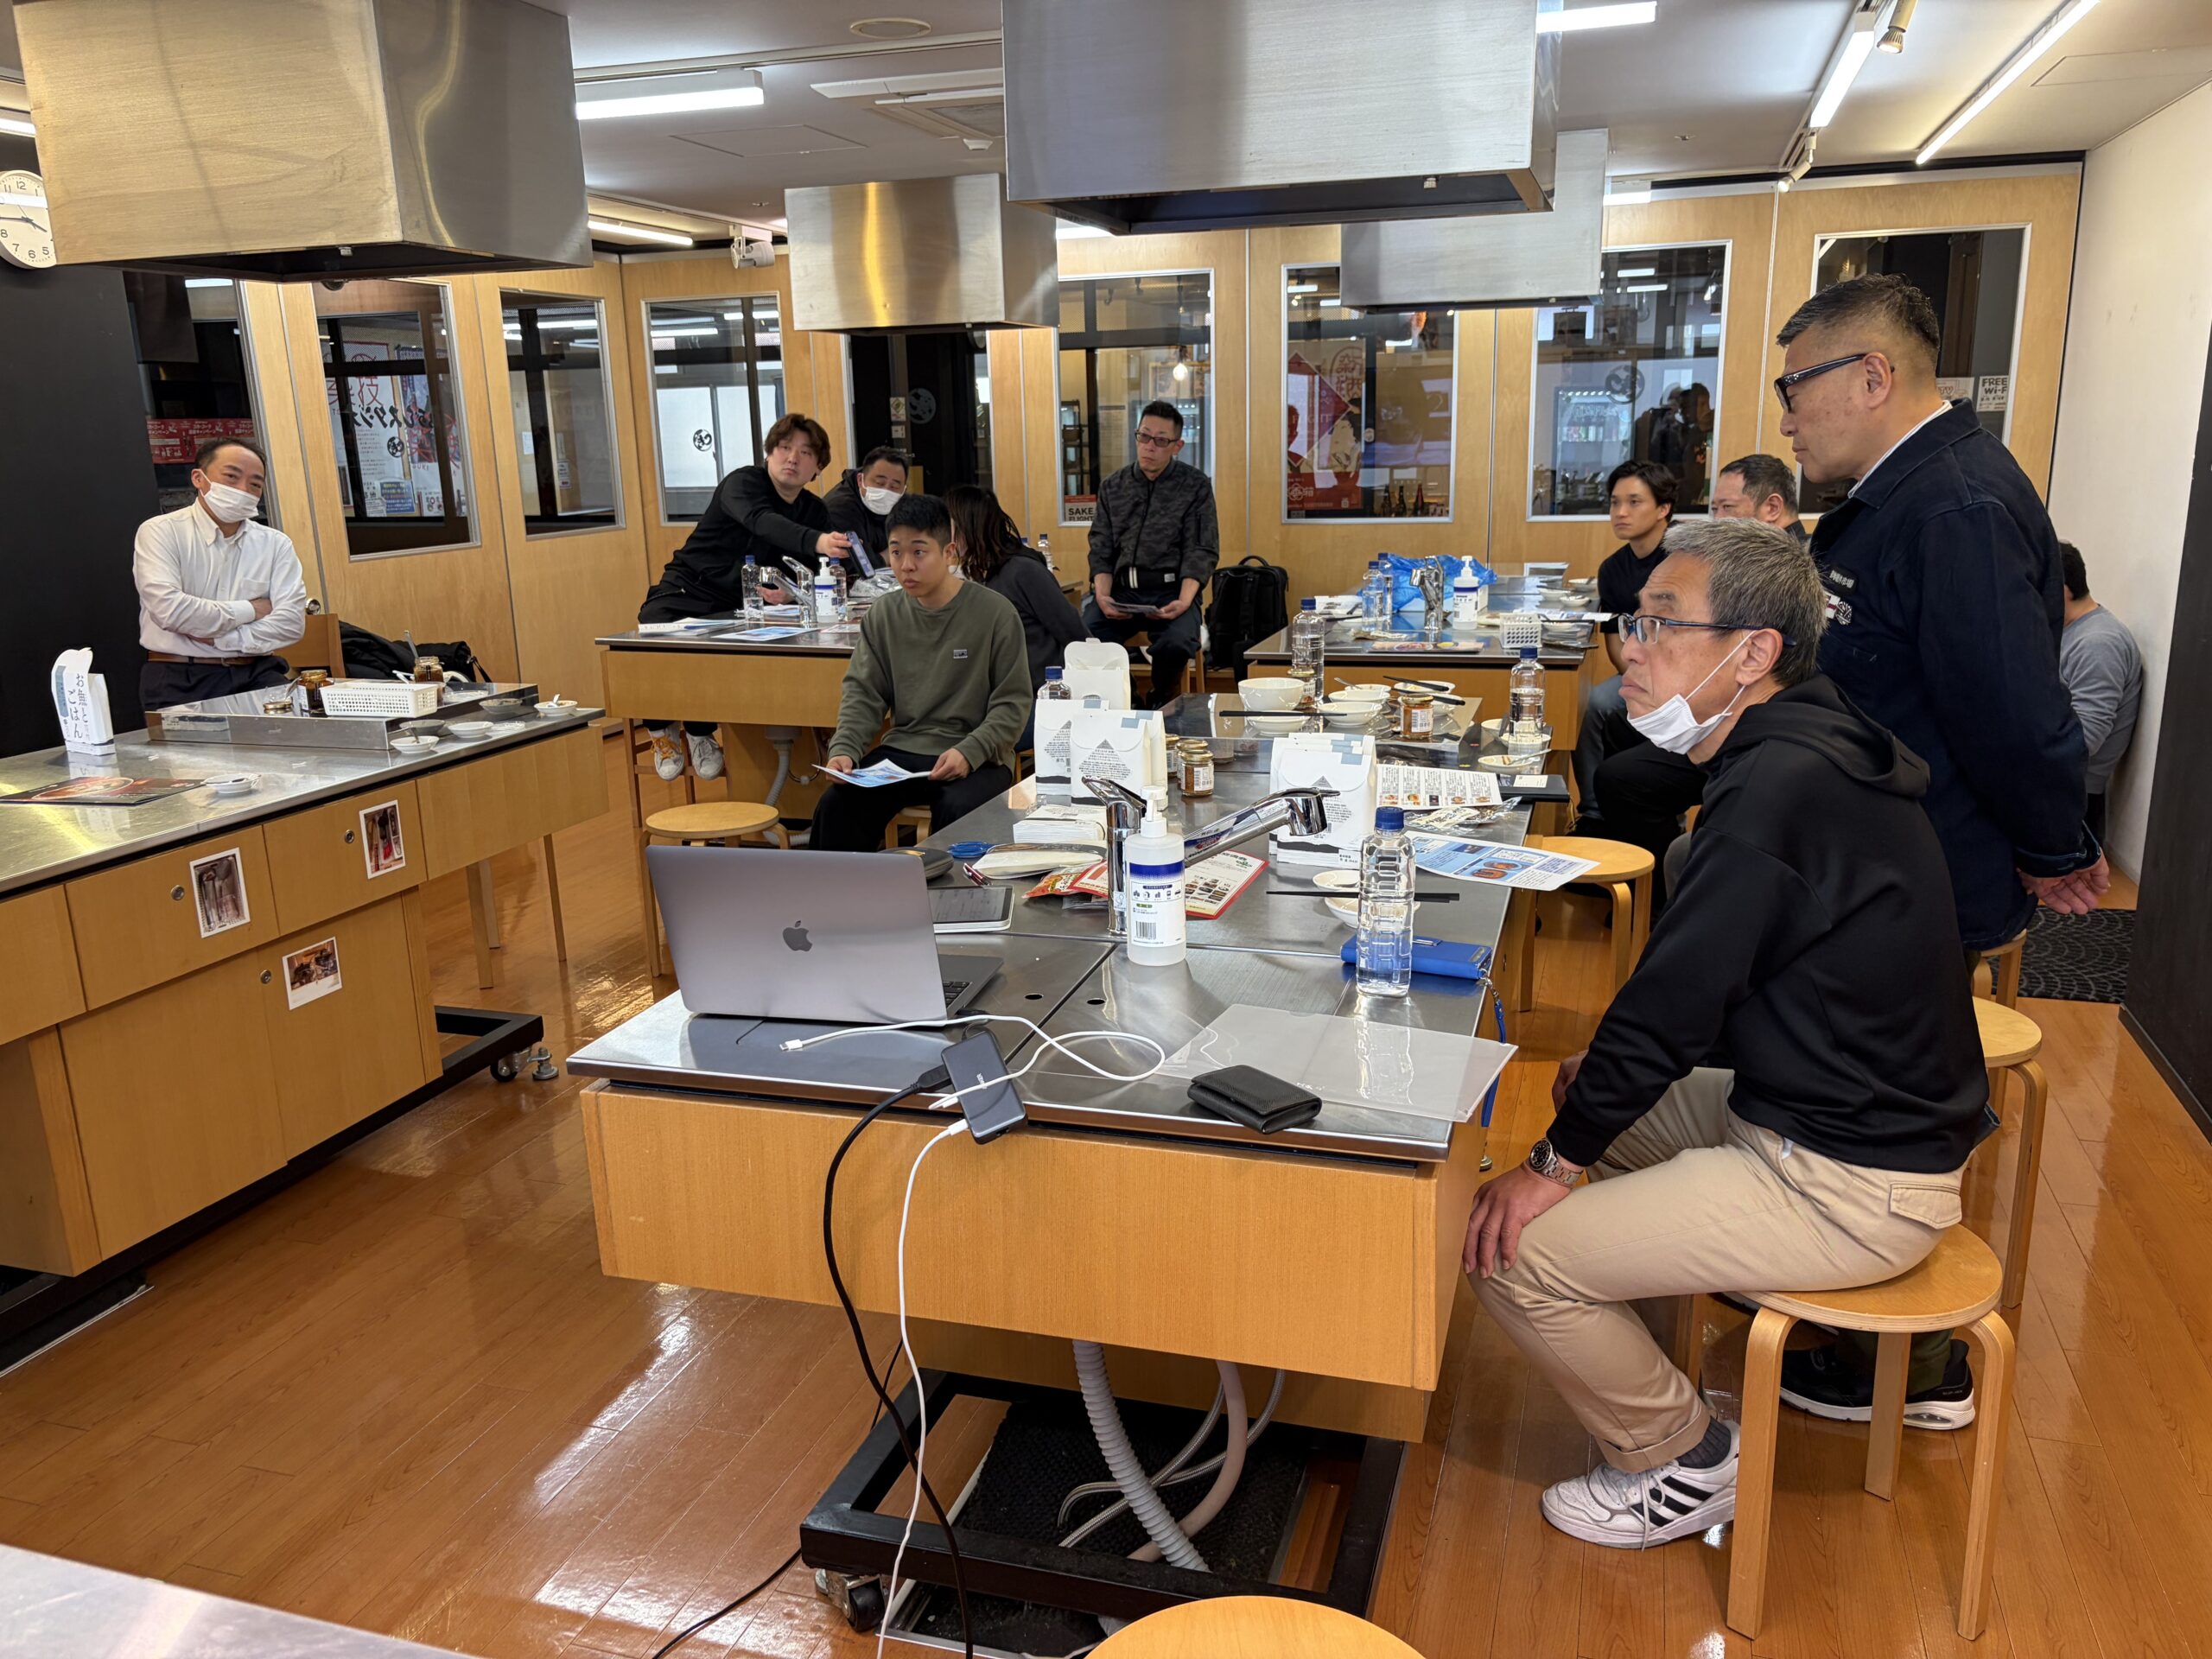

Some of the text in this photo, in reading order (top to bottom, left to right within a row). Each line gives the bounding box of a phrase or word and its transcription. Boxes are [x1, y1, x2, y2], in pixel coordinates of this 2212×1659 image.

[16, 180, 27, 191] 12
[0, 228, 9, 238] 8
[12, 243, 20, 252] 7
[41, 246, 50, 256] 5
[28, 250, 36, 259] 6
[1981, 377, 2008, 388] FREE
[1984, 385, 2008, 395] Wi-F
[1068, 507, 1094, 516] SAKE
[68, 689, 84, 739] ごはん
